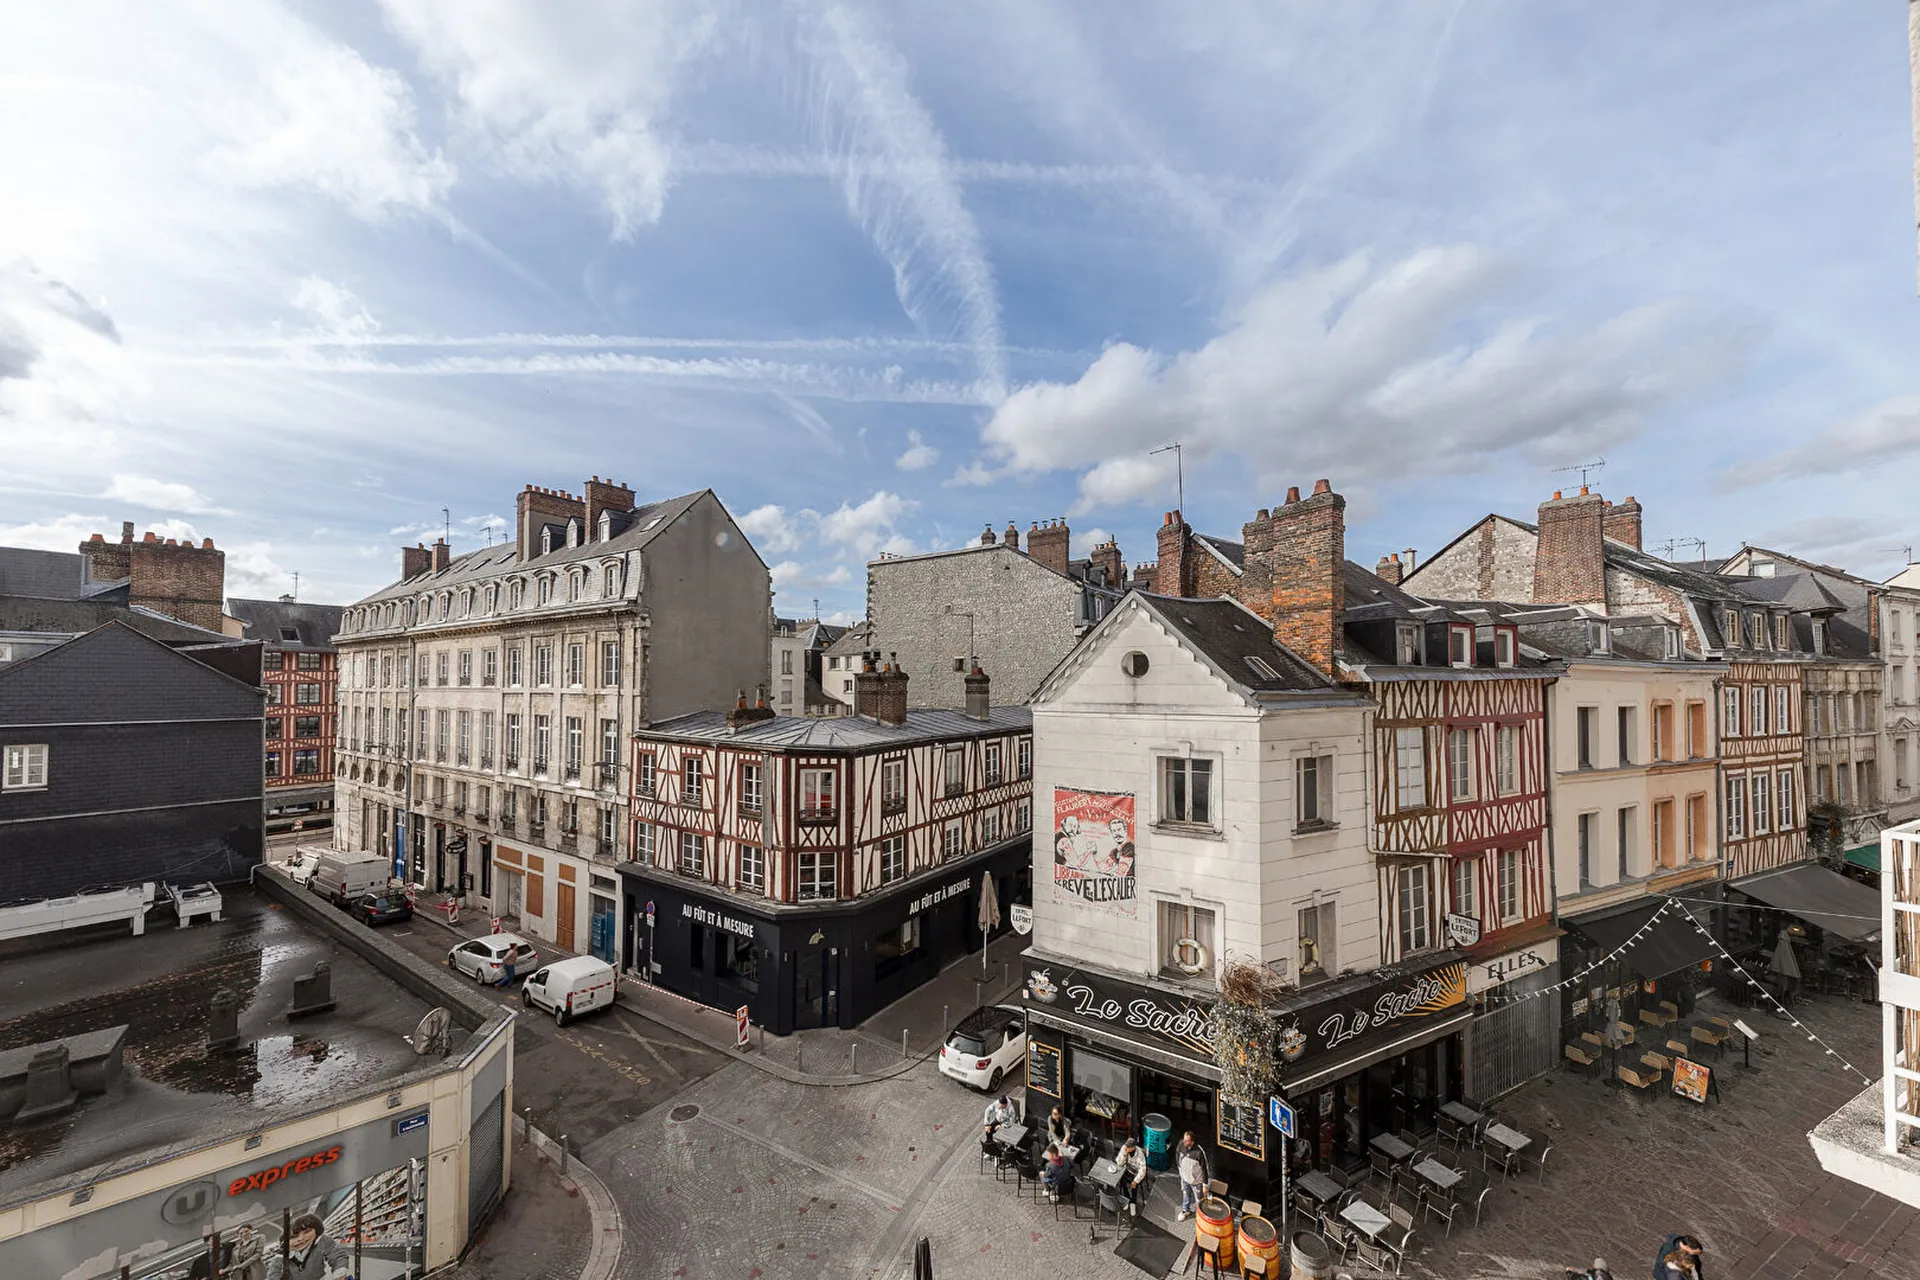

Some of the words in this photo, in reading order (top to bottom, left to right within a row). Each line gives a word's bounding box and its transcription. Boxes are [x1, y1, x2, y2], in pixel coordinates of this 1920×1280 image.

[909, 900, 920, 915] AU
[934, 890, 941, 904] ET
[947, 878, 970, 898] MESURE
[1093, 876, 1136, 902] L'ESCALIER
[682, 904, 692, 918] AU
[707, 911, 715, 925] ET
[716, 911, 722, 928] À
[723, 916, 754, 938] MESURE
[1012, 913, 1031, 924] LEFORT
[1450, 922, 1477, 937] LEFORT
[1488, 950, 1536, 979] ELLES
[1066, 985, 1122, 1020] Le
[1317, 1009, 1370, 1050] Le
[228, 1146, 342, 1197] express
